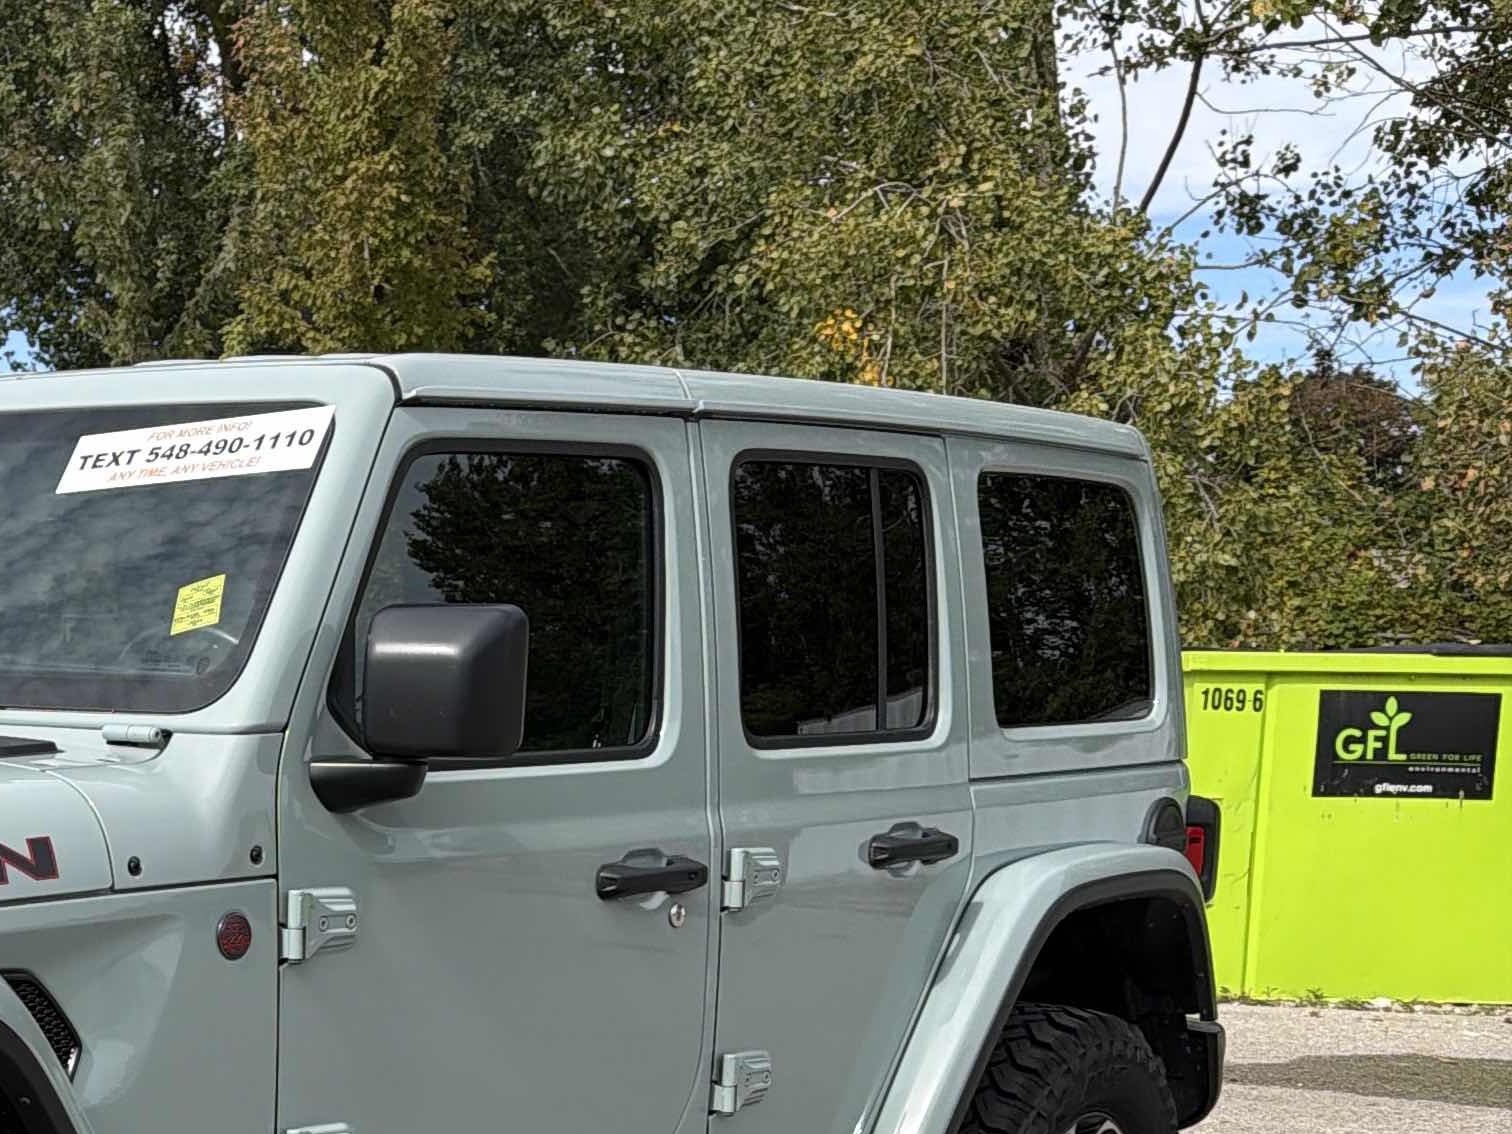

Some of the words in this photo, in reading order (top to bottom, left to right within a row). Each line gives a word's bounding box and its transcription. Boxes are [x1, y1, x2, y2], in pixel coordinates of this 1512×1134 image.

[78, 448, 143, 471] TEXT
[145, 428, 315, 464] 548-490-1110
[1335, 717, 1407, 760] GFL
[1409, 753, 1439, 761] GREEN
[1442, 753, 1460, 761] FOR
[1463, 754, 1482, 762] LIFE
